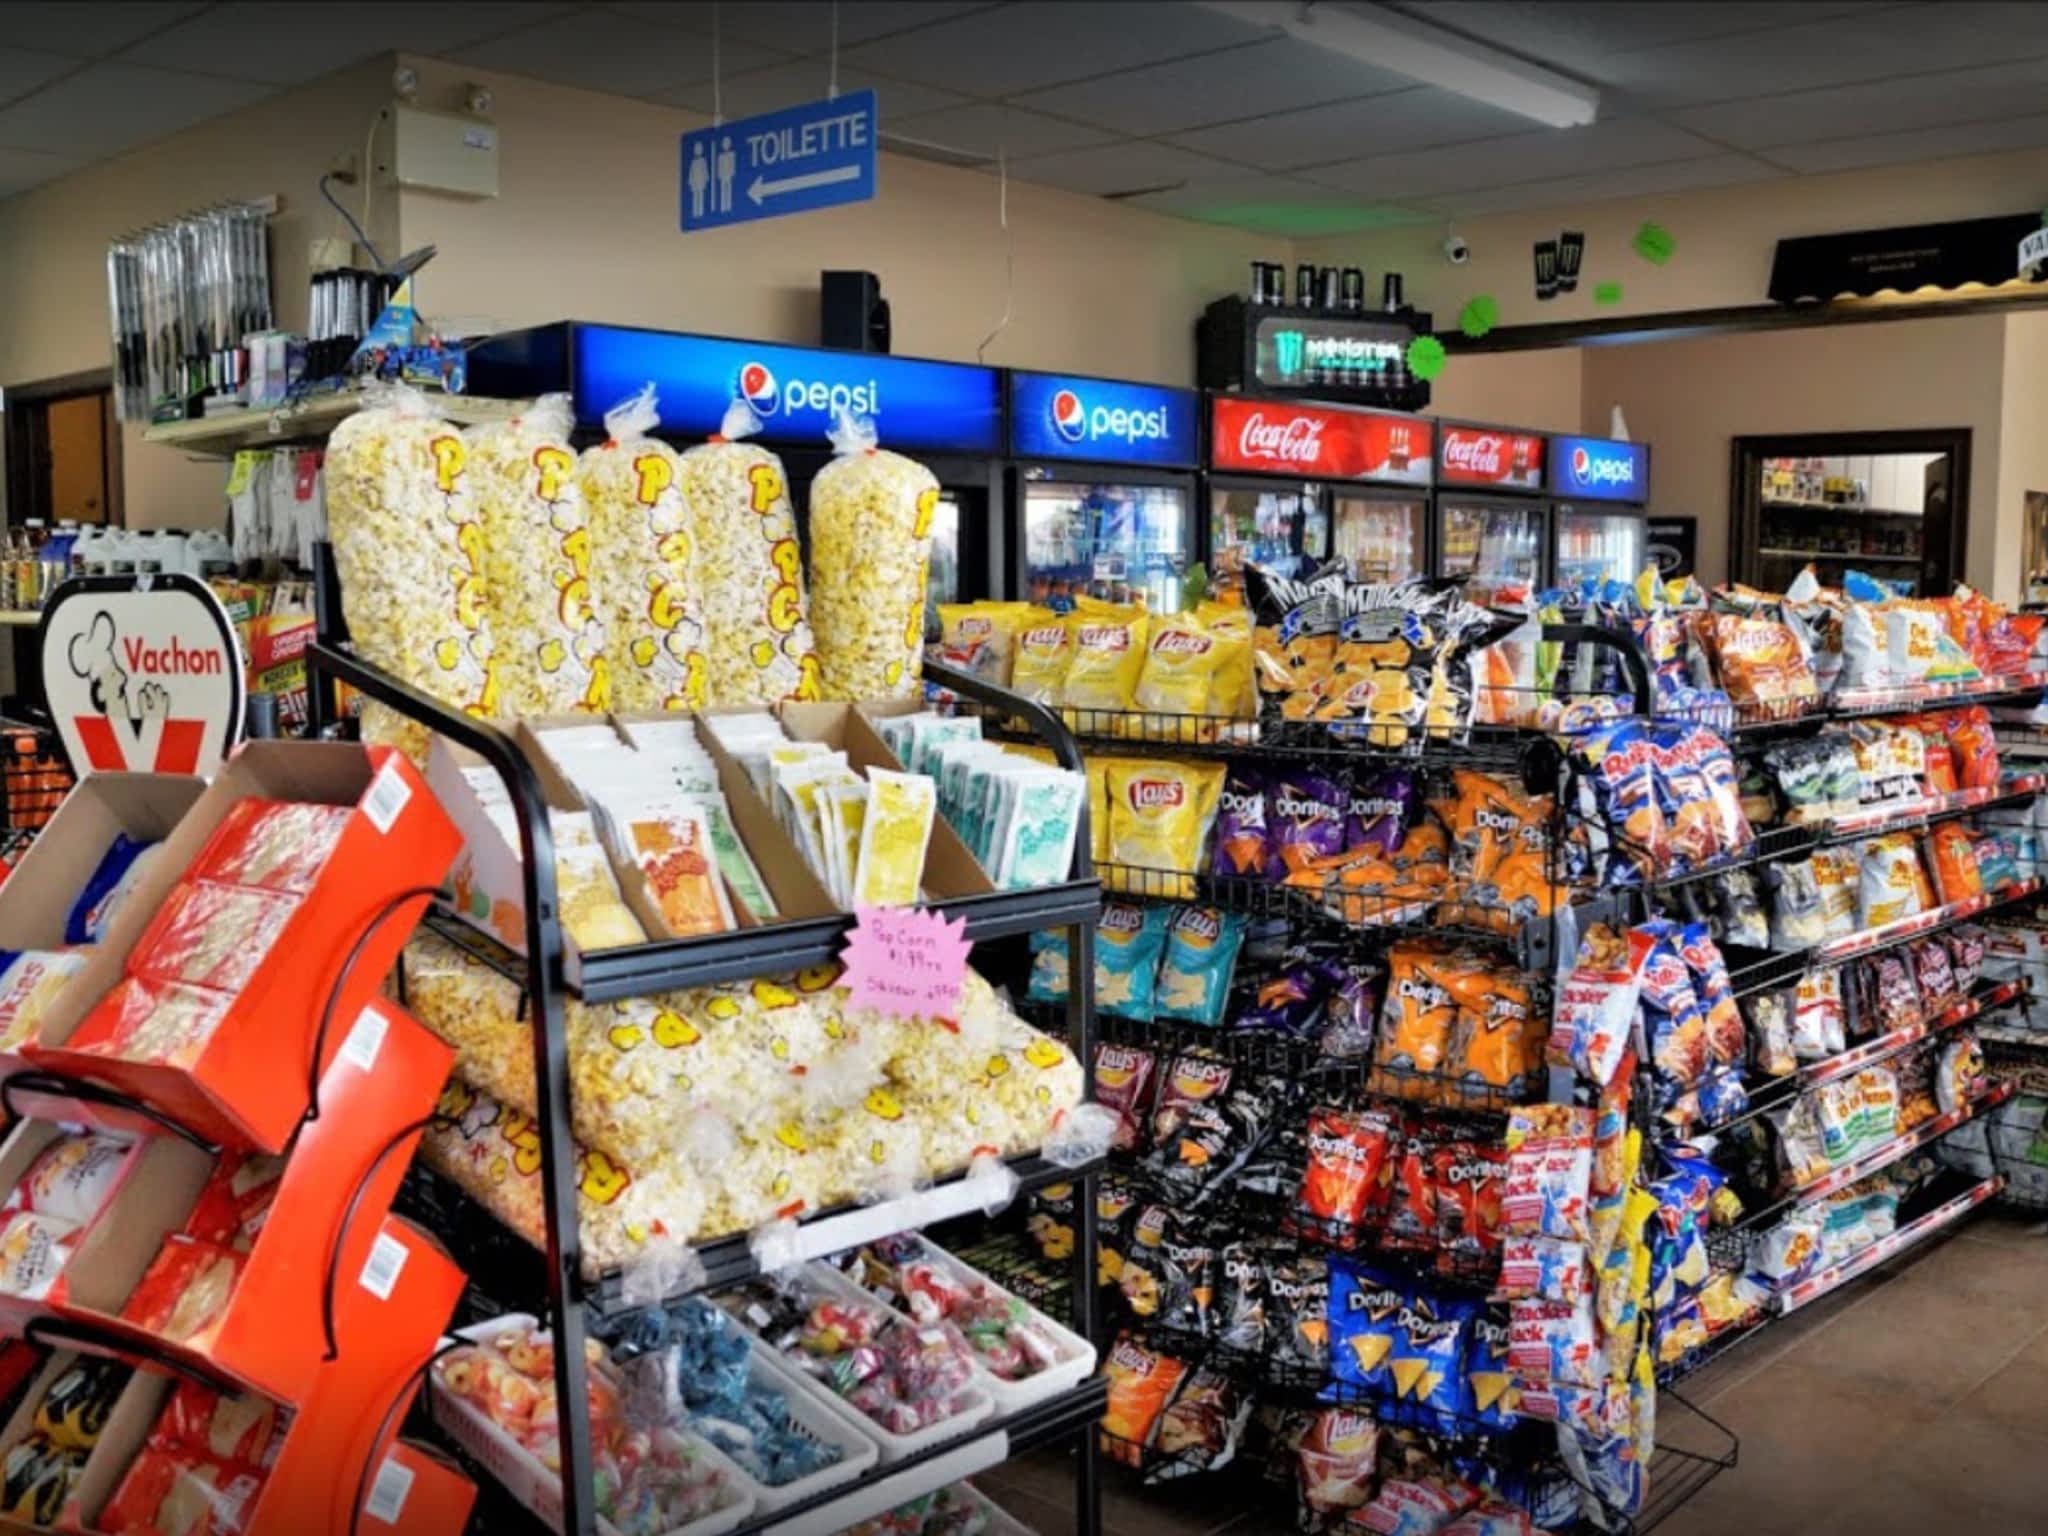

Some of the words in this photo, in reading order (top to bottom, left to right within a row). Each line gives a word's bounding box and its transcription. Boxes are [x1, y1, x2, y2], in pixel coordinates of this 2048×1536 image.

[747, 111, 867, 168] TOILETTE
[784, 379, 880, 418] pepsi
[1091, 406, 1169, 444] pepsi
[1591, 454, 1635, 486] pepsi
[123, 635, 222, 675] Vachon
